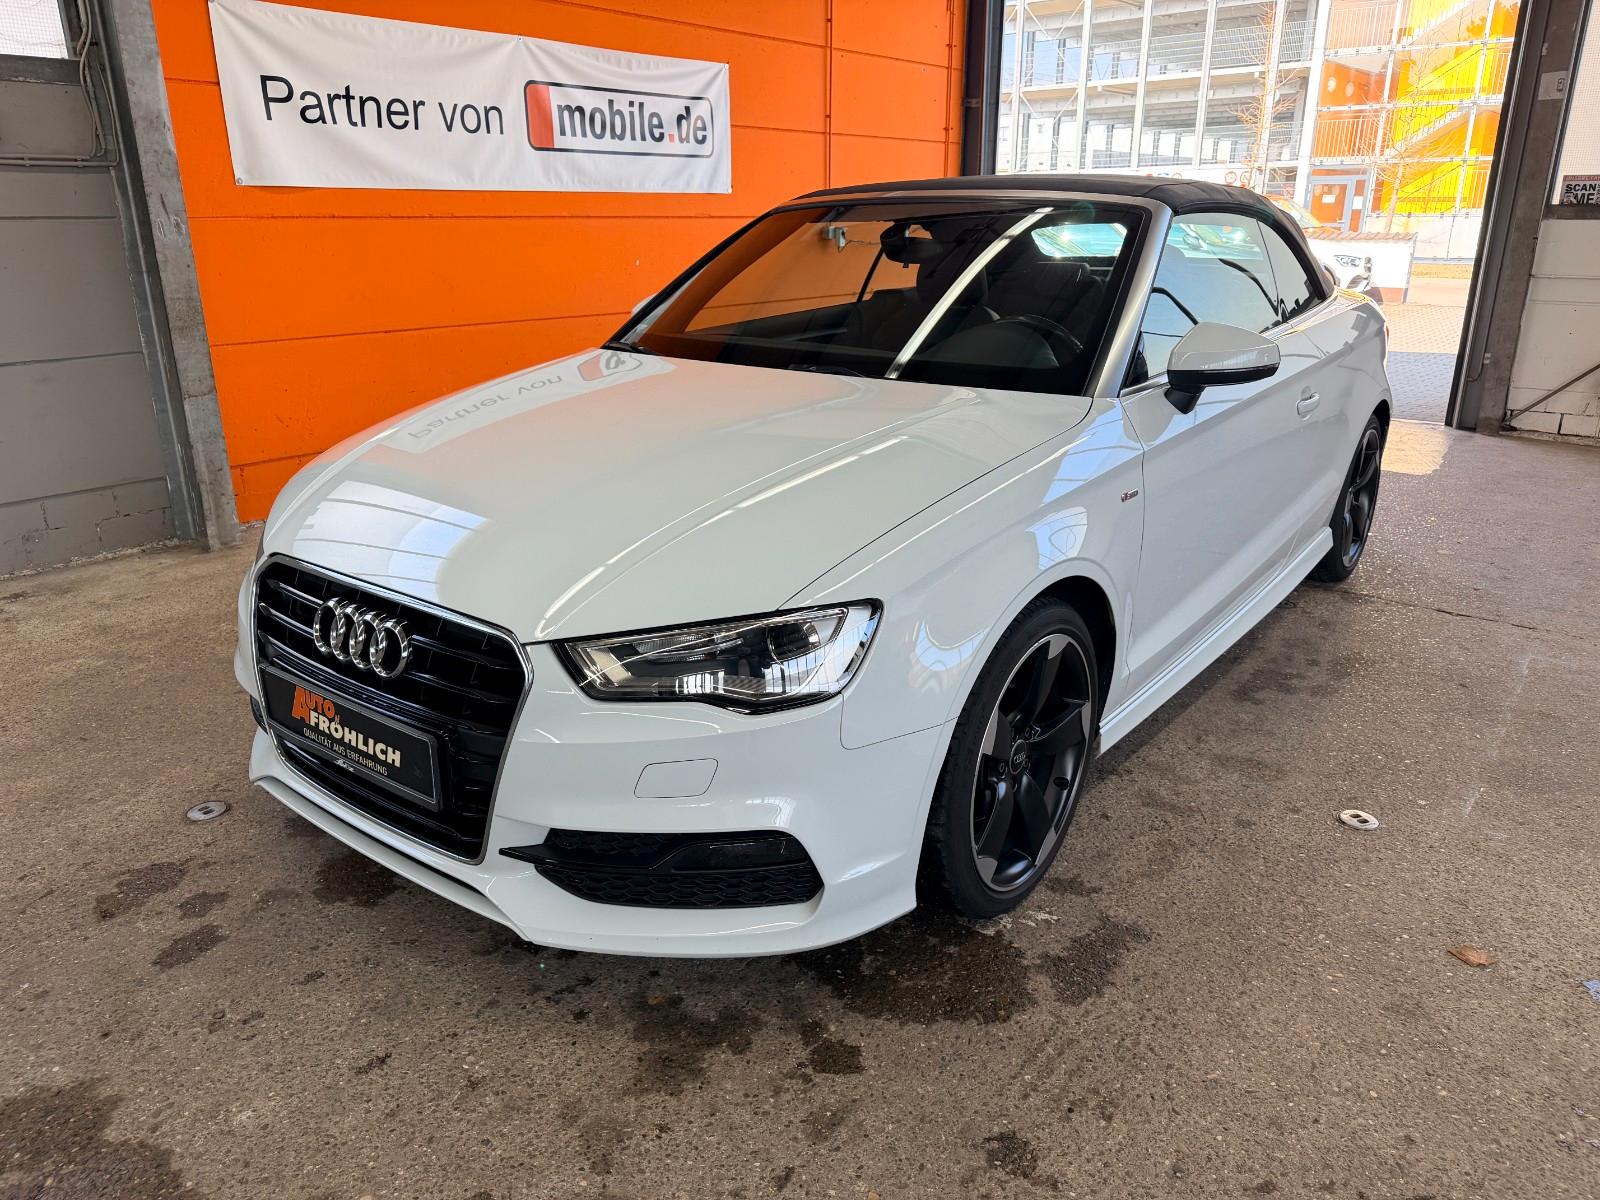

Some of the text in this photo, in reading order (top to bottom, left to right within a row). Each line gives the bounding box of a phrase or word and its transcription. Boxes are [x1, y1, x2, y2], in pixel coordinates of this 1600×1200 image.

[260, 75, 707, 144] Partner von mobile.de
[1565, 183, 1597, 192] SCAN
[292, 685, 335, 724] AUTO
[303, 727, 332, 749] QUALITÄT
[333, 743, 346, 756] AUS
[346, 749, 388, 776] ERFAHRUNG
[309, 711, 401, 768] FRÖHLICH
